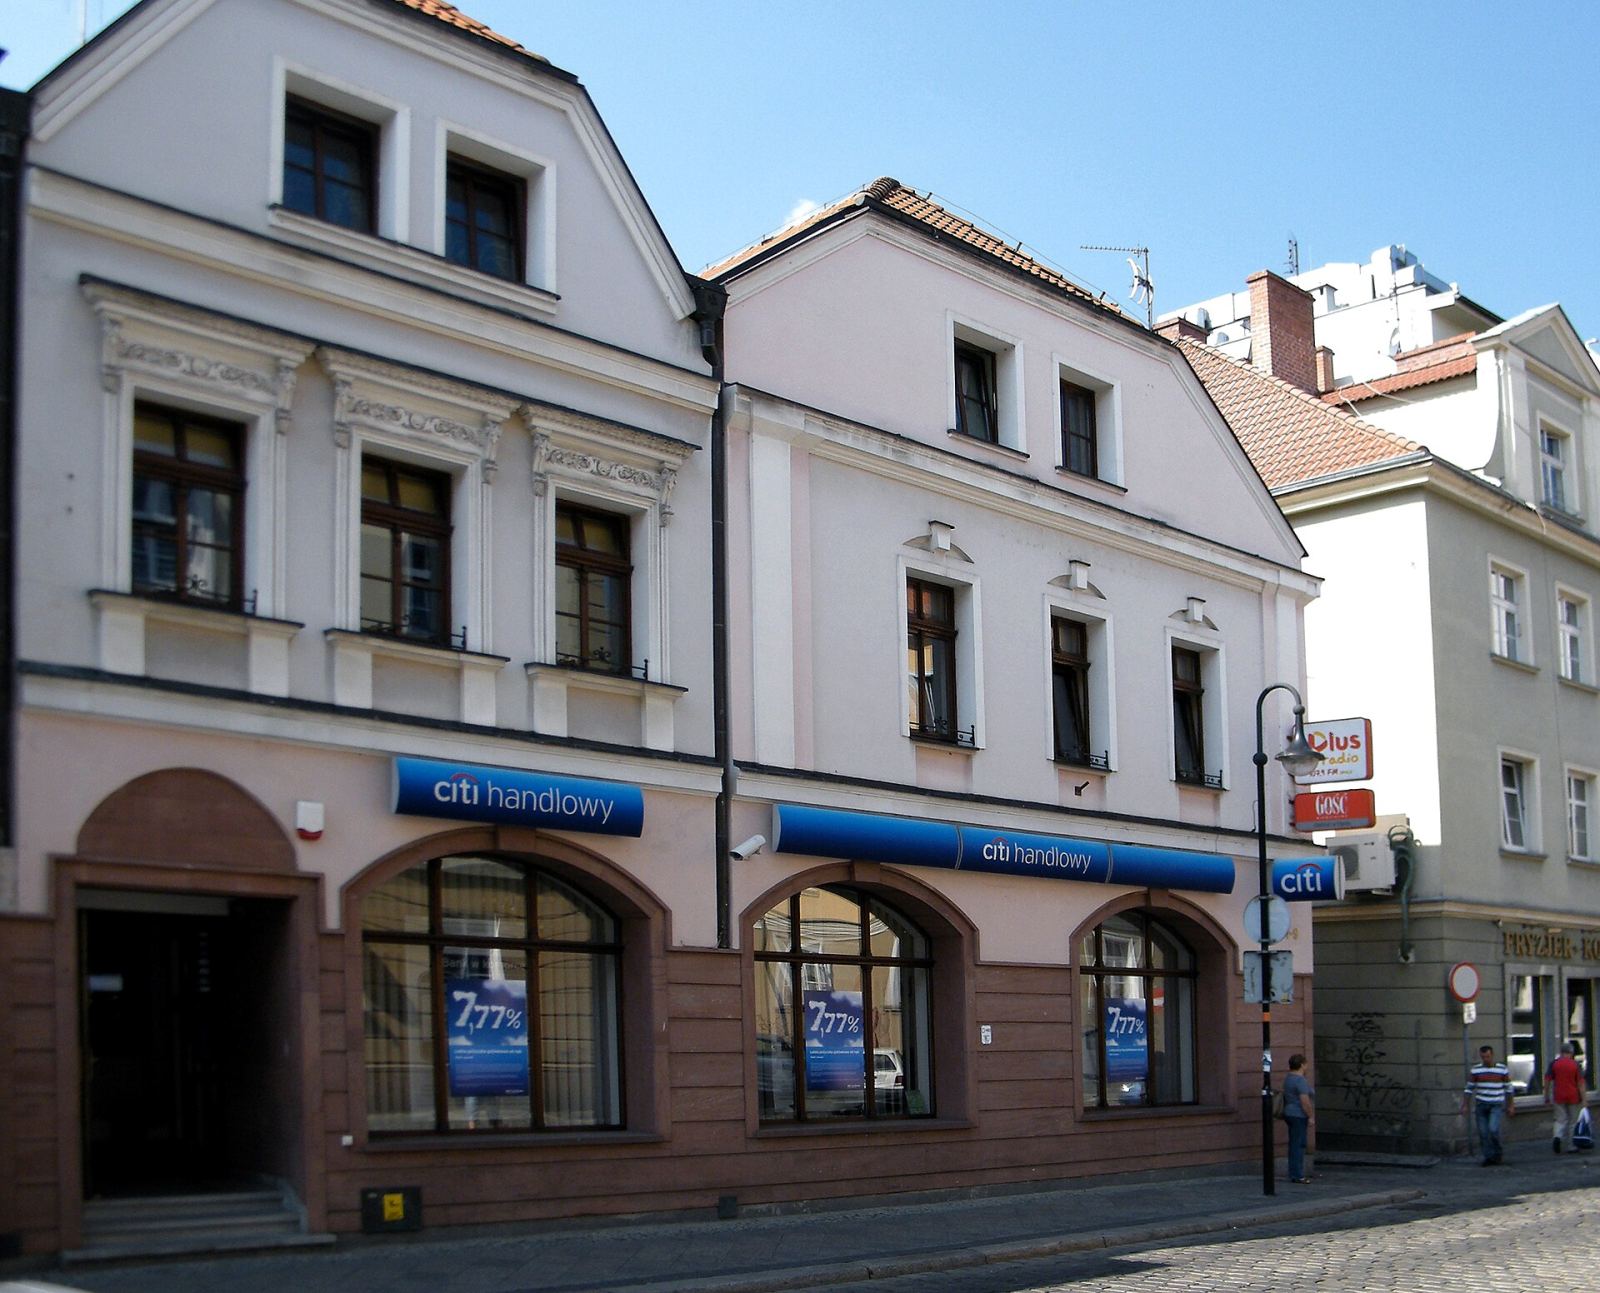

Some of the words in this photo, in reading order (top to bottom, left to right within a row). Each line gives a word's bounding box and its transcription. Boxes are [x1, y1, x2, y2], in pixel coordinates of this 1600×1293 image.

[434, 777, 479, 805] citi
[487, 780, 614, 824] handlowy
[982, 840, 1010, 862] citi
[1014, 842, 1092, 874] handlowy
[1281, 866, 1322, 893] citi
[453, 990, 522, 1034] 7,77%
[808, 1000, 859, 1038] 7,77%
[1108, 1006, 1144, 1038] 7,77%
